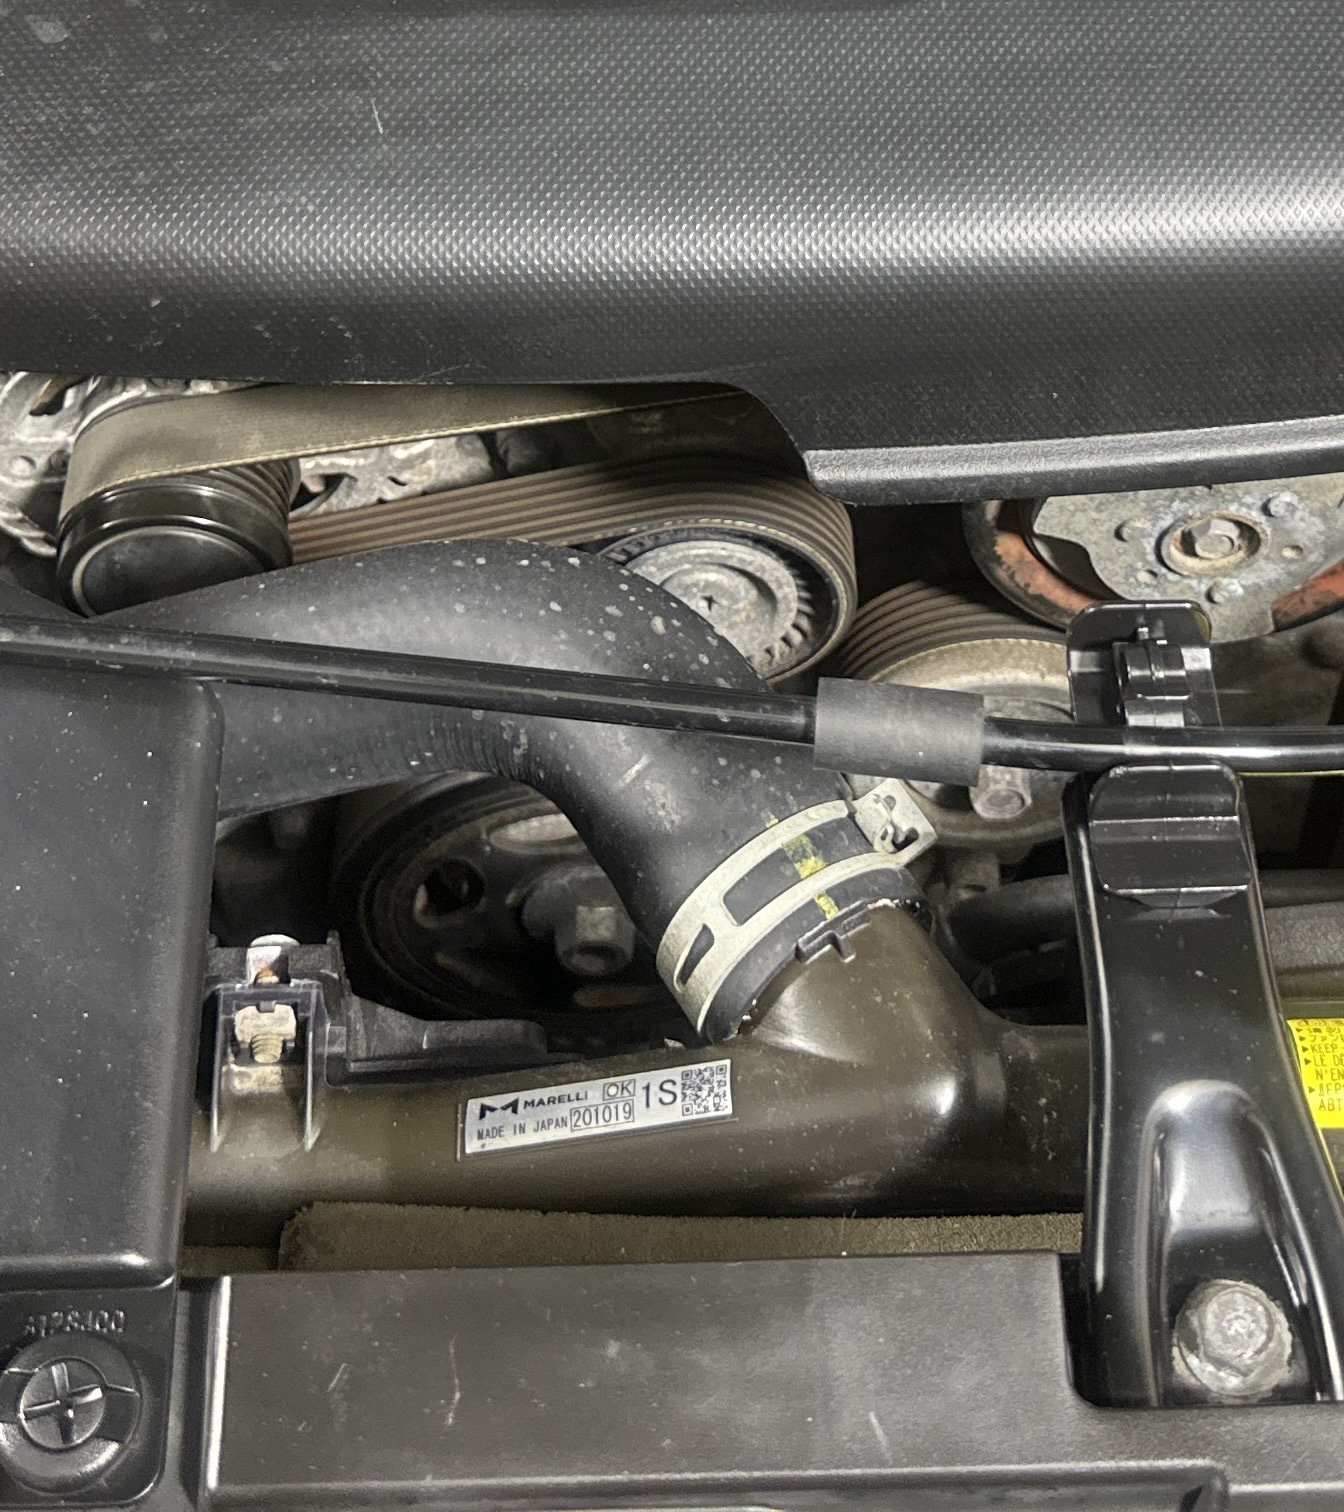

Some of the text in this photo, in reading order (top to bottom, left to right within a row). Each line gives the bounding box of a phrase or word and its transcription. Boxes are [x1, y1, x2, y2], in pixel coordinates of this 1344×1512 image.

[1311, 1043, 1338, 1053] KEEP
[1315, 1068, 1344, 1081] N'EN
[606, 1081, 633, 1097] OK
[642, 1079, 677, 1108] 1S
[523, 1091, 588, 1110] MARELLI
[477, 1103, 632, 1140] MADE IN JAPAN 201019
